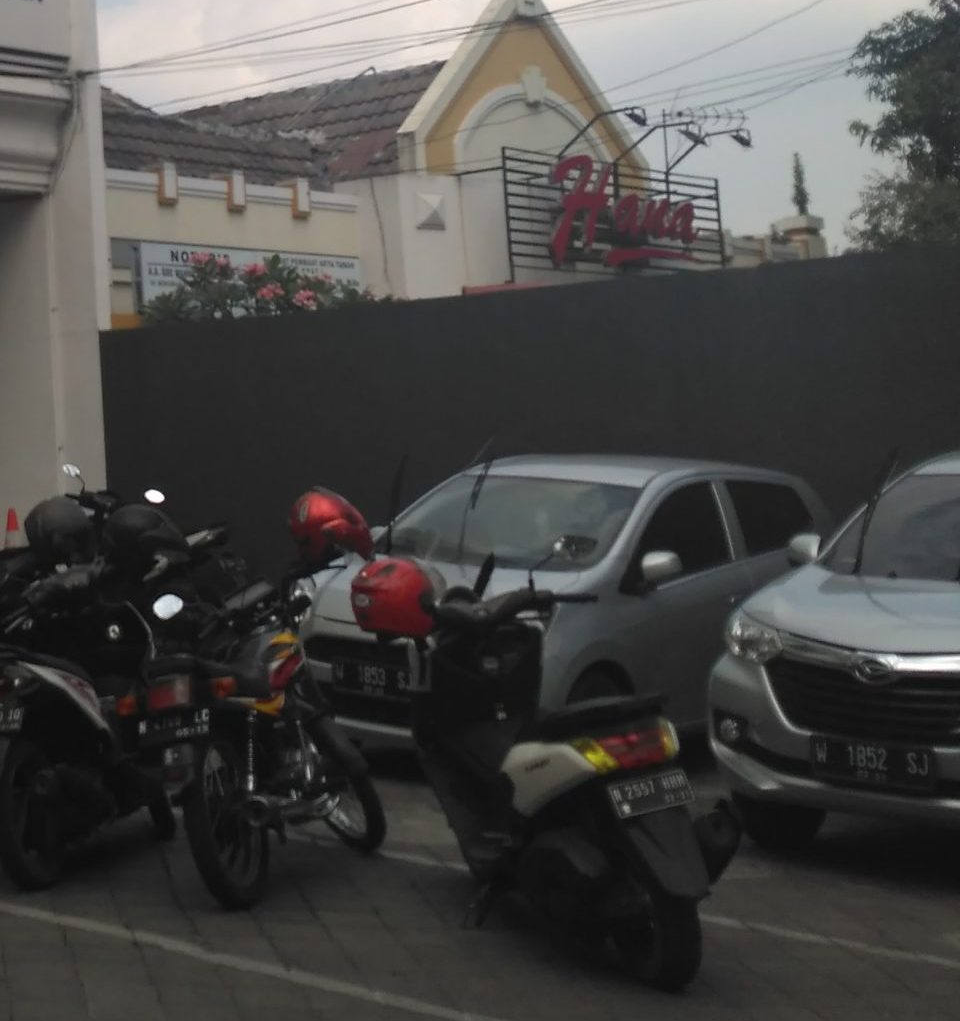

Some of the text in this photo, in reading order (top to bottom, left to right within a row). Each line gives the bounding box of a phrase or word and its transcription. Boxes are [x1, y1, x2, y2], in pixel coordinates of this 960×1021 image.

[815, 742, 827, 764] W
[847, 745, 889, 771] 1852
[906, 752, 929, 776] SJ
